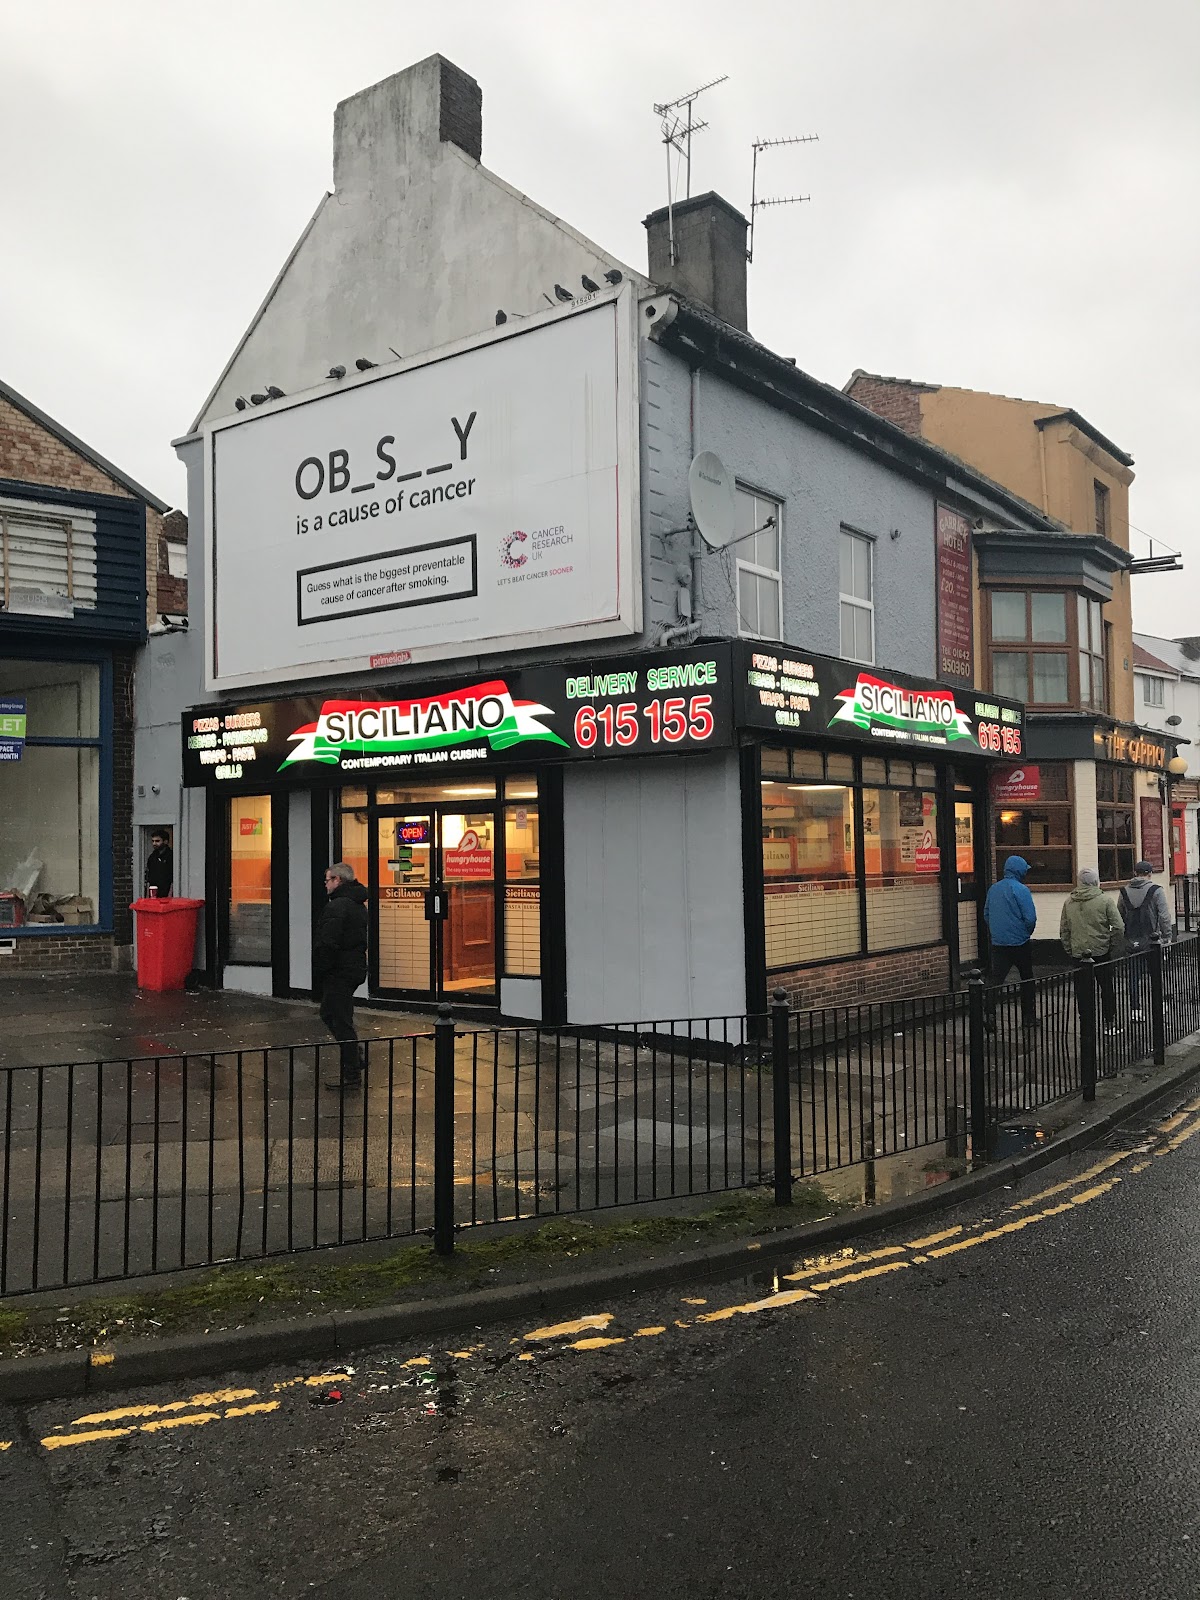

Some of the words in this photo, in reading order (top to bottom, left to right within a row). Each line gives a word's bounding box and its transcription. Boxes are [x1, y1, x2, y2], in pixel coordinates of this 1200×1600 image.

[296, 515, 309, 535] is
[313, 515, 323, 531] a
[328, 501, 380, 527] cause
[385, 489, 405, 514] of
[409, 478, 476, 508] cancer
[531, 525, 565, 540] CANCER
[940, 516, 969, 543] GARRICK
[531, 534, 574, 551] RESEARCH
[943, 532, 964, 553] HOTEL
[531, 551, 543, 561] UK
[306, 582, 331, 594] Guess
[332, 576, 353, 588] what
[354, 573, 362, 584] is
[363, 571, 378, 582] the
[379, 564, 411, 580] biggest
[412, 554, 465, 575] preventable
[497, 577, 512, 586] LET'S
[512, 574, 526, 583] BEAT
[526, 570, 548, 581] CANCER
[549, 565, 574, 576] SOONER
[320, 592, 345, 605] cause
[346, 589, 355, 601] of
[356, 585, 386, 599] cancer
[386, 581, 407, 594] after
[408, 573, 450, 590] smoking.
[372, 651, 411, 666] primesight
[952, 648, 970, 661] 01642
[752, 653, 778, 673] PIZZAS
[782, 659, 814, 680] BURGERS
[942, 657, 971, 678] 350360
[566, 671, 638, 699] DELIVERY
[647, 661, 718, 691] SERVICE
[747, 670, 776, 690] KEBABS
[759, 689, 785, 708] WRAPS
[789, 694, 811, 712] PASTA
[861, 685, 953, 724] SICILIANO
[193, 716, 220, 733] PIZZAS
[224, 711, 262, 730] BURGERS
[325, 696, 506, 744] SICILIANO
[574, 702, 639, 749] 615
[643, 694, 714, 743] 155
[775, 709, 800, 727] GRILLS
[974, 701, 1000, 720] DELIVERY
[1001, 707, 1022, 725] SERVICE
[188, 733, 217, 750] KEBABS
[871, 727, 911, 740] CONTEMPORARY
[911, 732, 930, 743] ITALIAN
[978, 721, 1001, 751] 615
[1001, 726, 1022, 755] 155
[199, 748, 227, 765] WRAPS
[231, 746, 257, 762] PASTA
[1107, 734, 1126, 760] THE
[341, 753, 413, 770] CONTEMPORARY
[414, 750, 448, 764] ITALIAN
[450, 748, 488, 761] CUISINE
[215, 763, 243, 780] GRILLS
[995, 782, 1038, 792] hungryhouse
[402, 826, 422, 839] OPEN
[446, 853, 491, 865] hungryhouse
[385, 888, 421, 898] Siciliano
